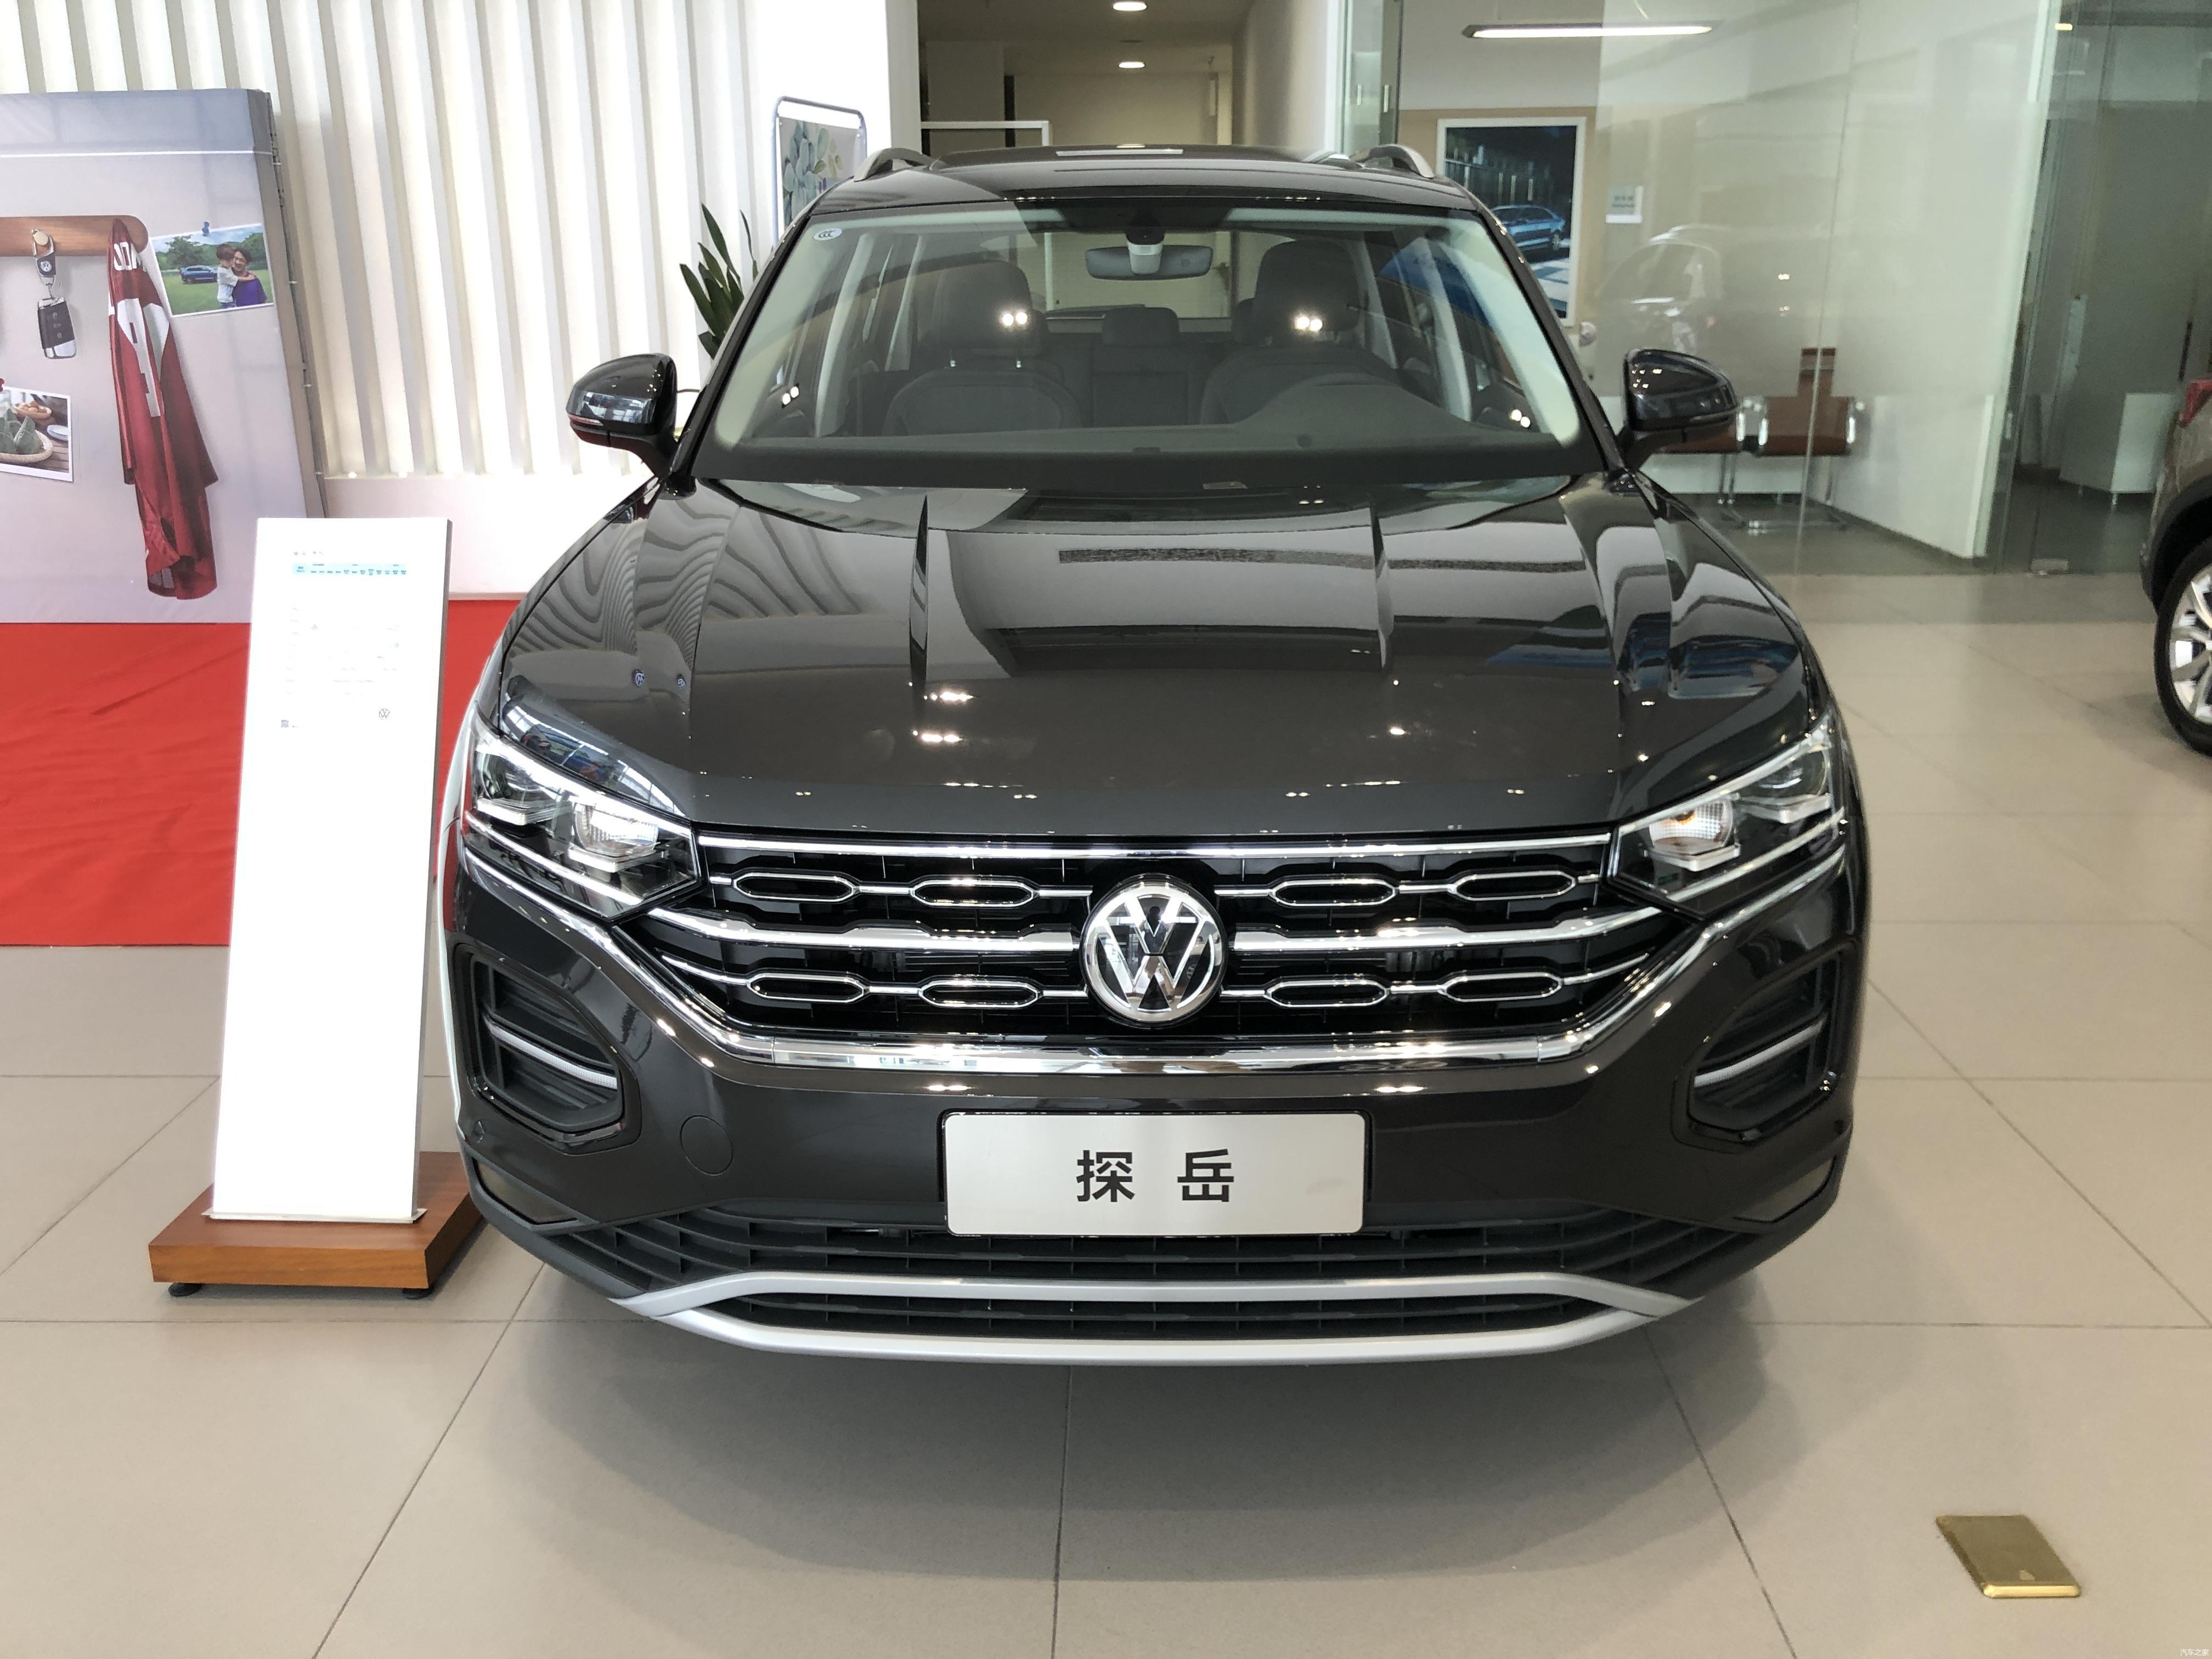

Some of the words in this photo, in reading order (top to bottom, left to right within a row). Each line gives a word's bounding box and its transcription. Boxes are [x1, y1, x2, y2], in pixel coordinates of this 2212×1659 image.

[379, 708, 391, 720] VW
[1085, 881, 1223, 1022] VW
[1076, 1148, 1234, 1203] 探岳
